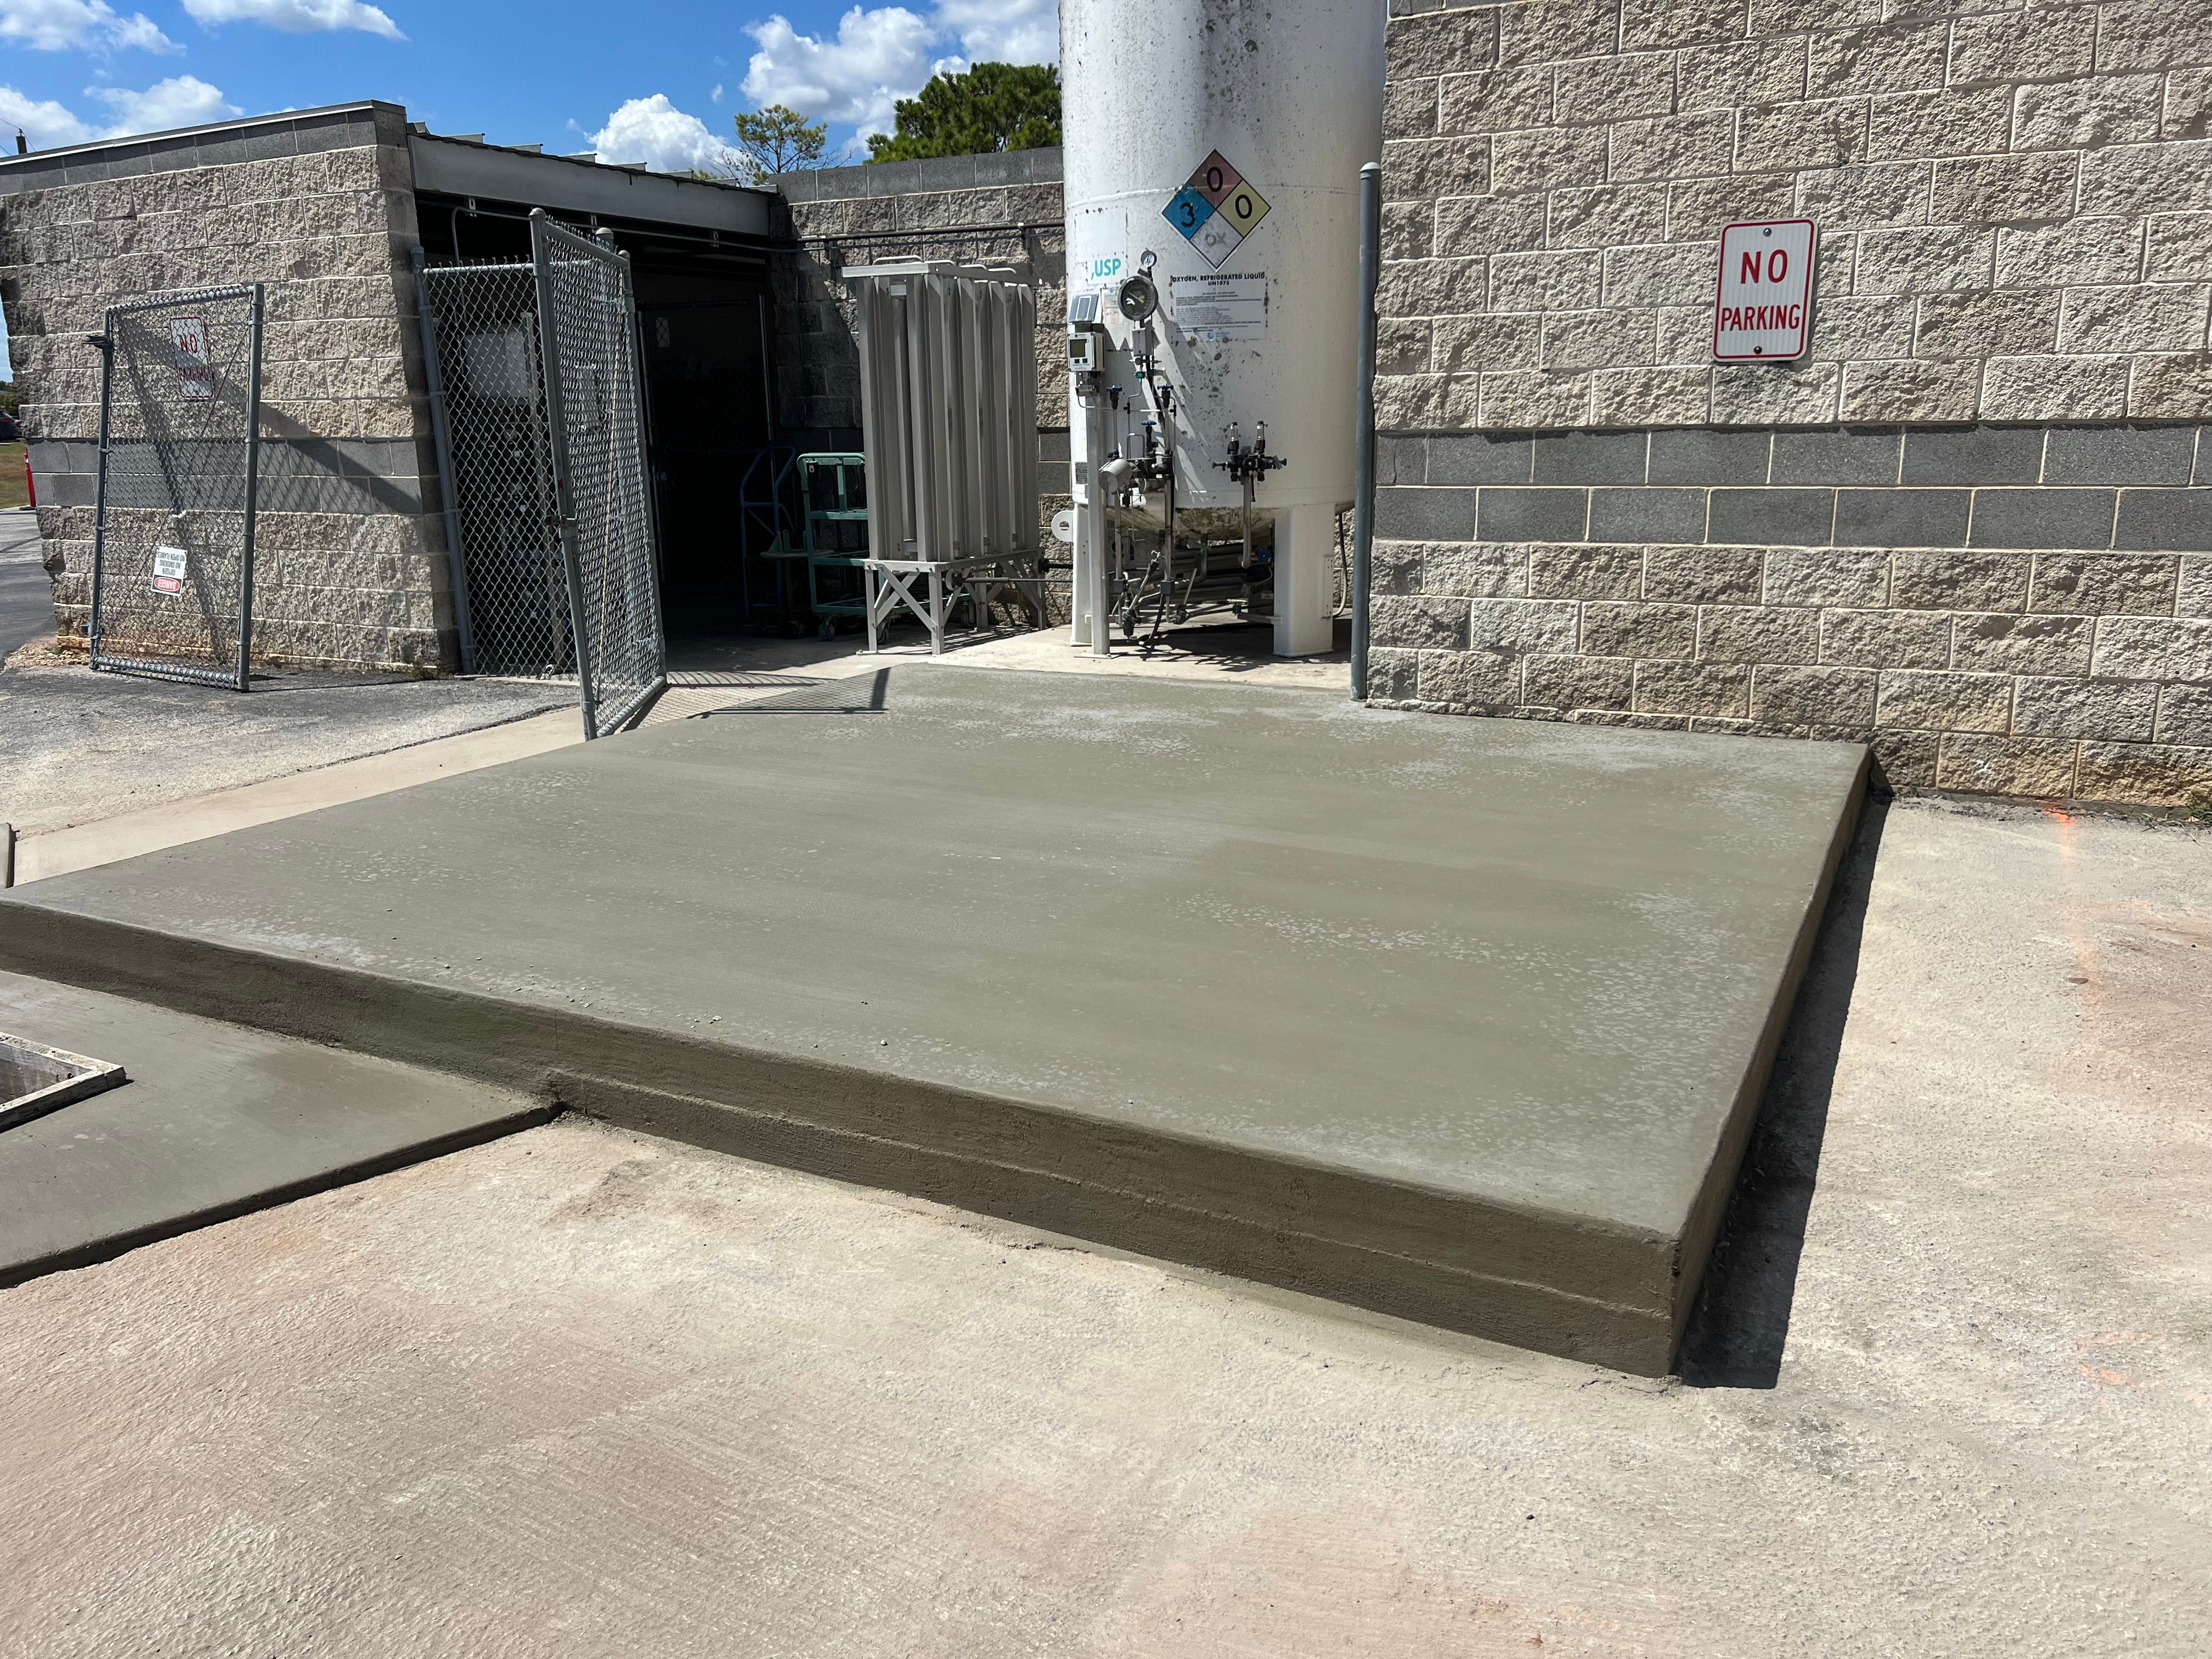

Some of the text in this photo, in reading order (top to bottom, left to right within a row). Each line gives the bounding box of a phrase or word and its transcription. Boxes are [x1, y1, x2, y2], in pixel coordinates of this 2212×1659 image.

[1207, 167, 1223, 192] 0
[1180, 194, 1252, 227] 3 0
[1740, 249, 1788, 284] NO
[1720, 304, 1801, 331] PARKING
[179, 334, 198, 353] NO
[157, 578, 177, 590] DANGER
